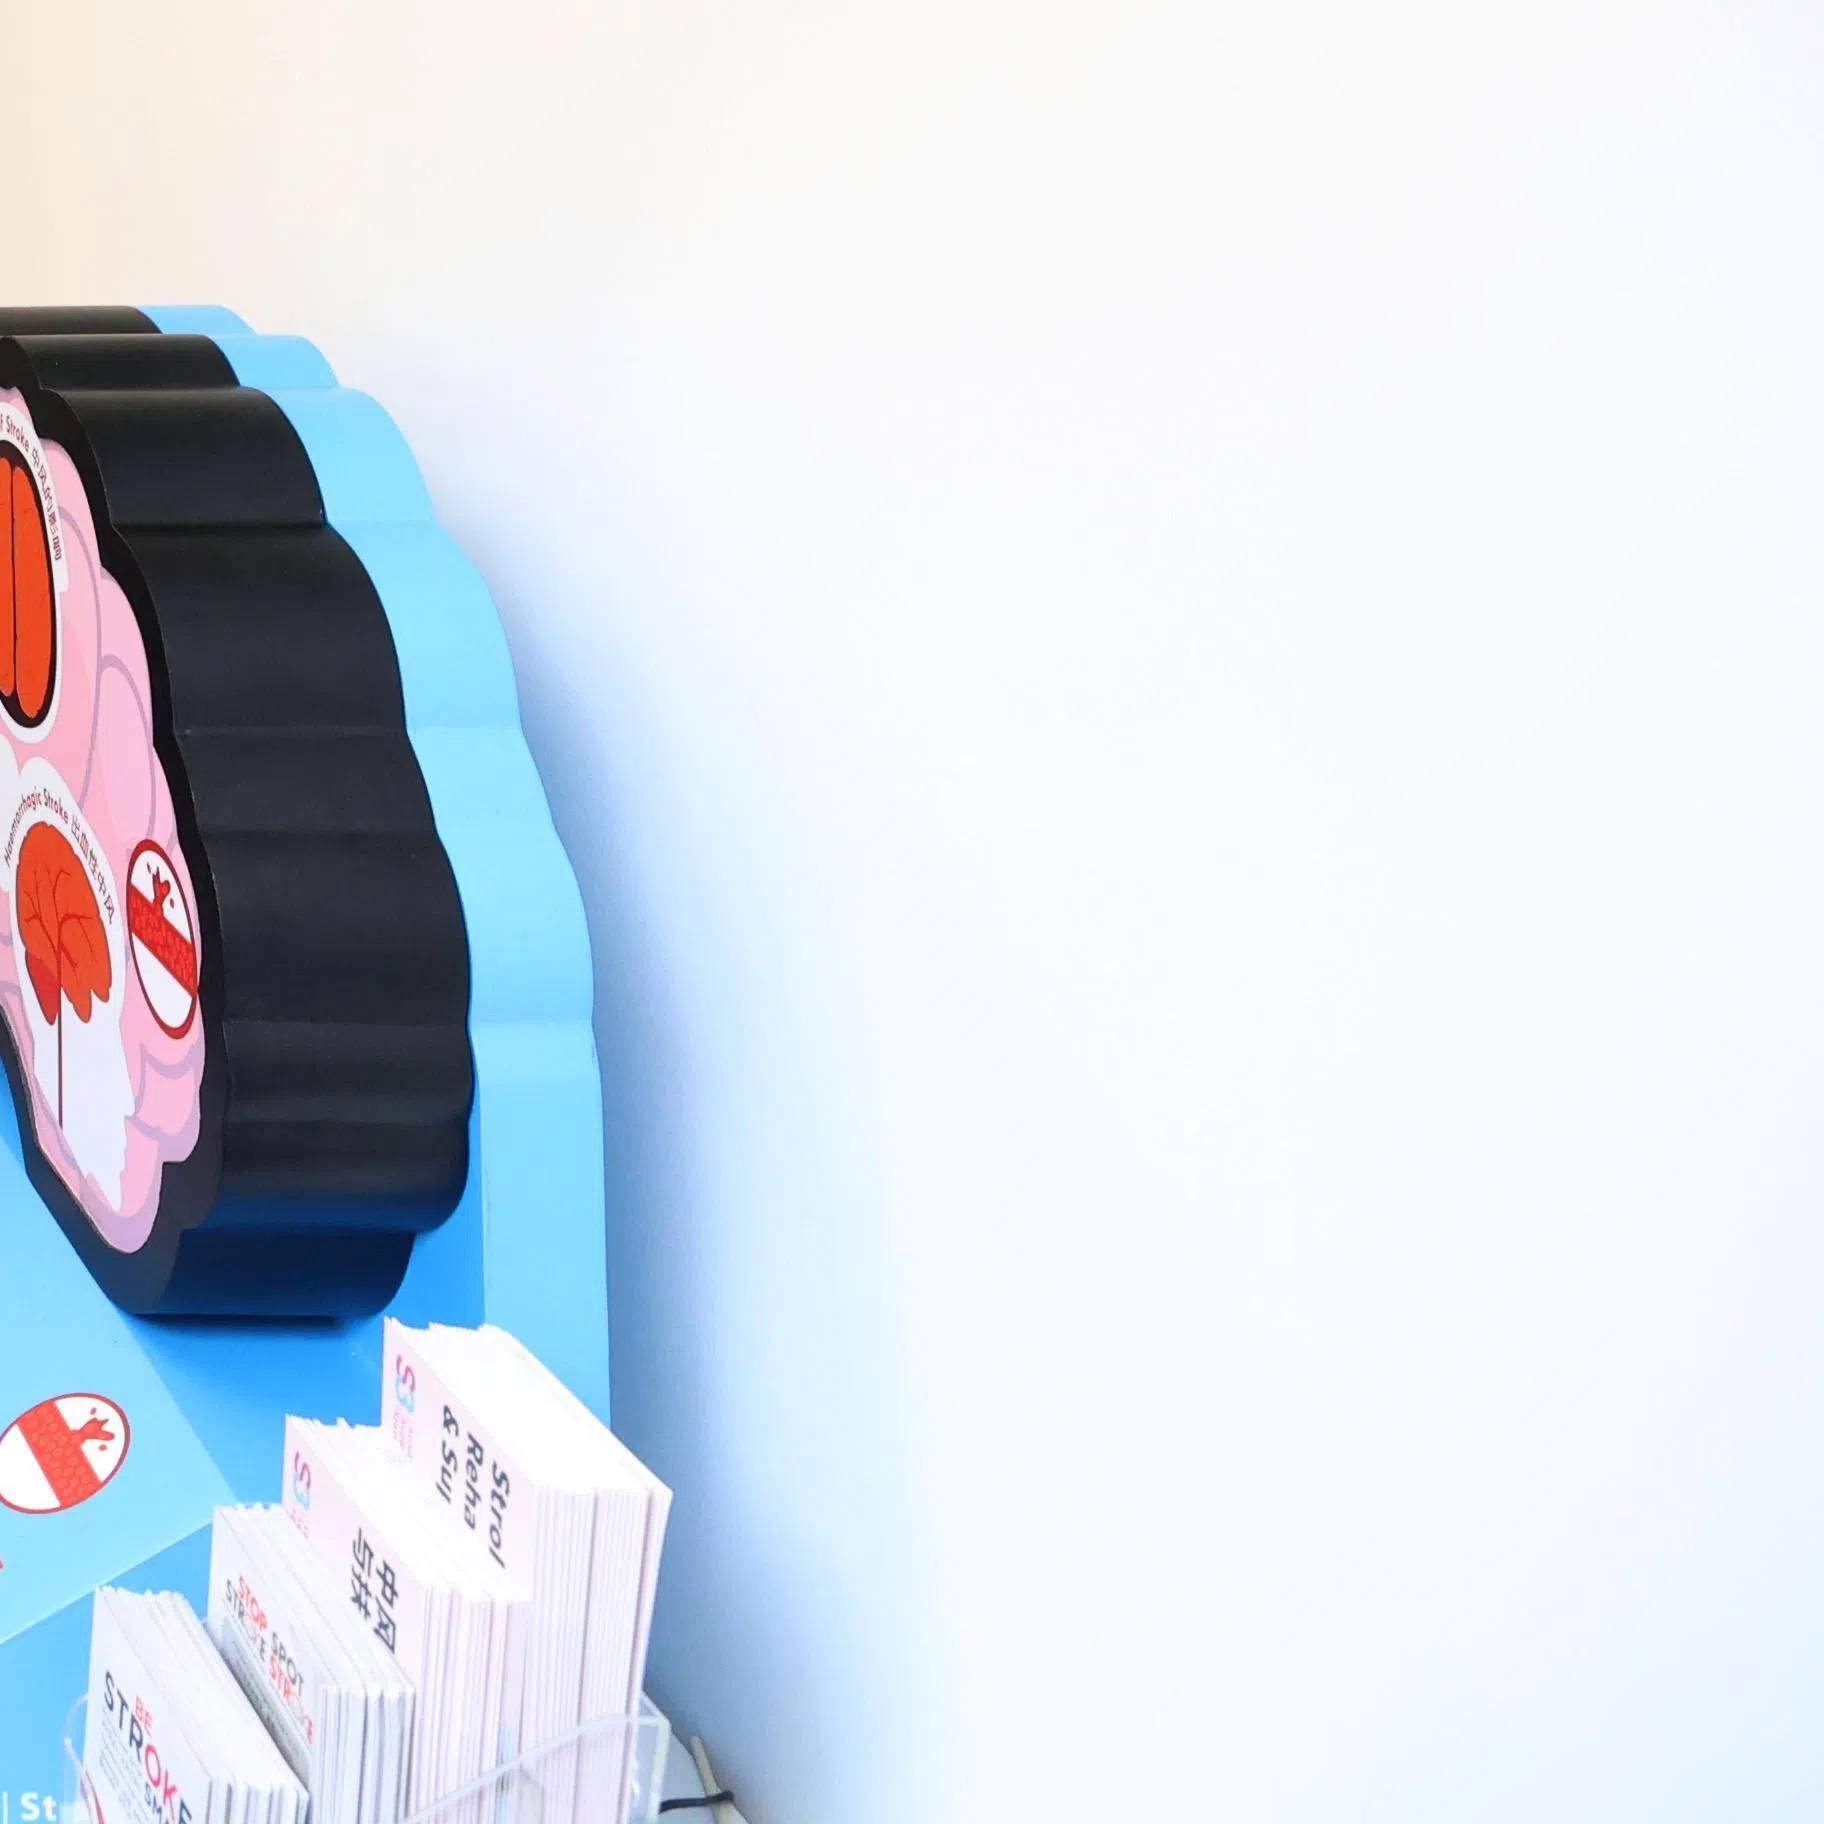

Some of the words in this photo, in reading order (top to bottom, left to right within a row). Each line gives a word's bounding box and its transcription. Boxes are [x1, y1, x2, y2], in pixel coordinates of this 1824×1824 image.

[6, 415, 30, 452] Stroke
[4, 786, 42, 867] Haemorrhagic
[43, 788, 69, 824] Stroke
[71, 815, 115, 924] 出血性中风
[443, 1404, 459, 1438] &
[238, 1574, 268, 1631] STOP
[271, 1631, 304, 1697] SPOT
[373, 1559, 399, 1654] 中风
[135, 1694, 153, 1736] BE
